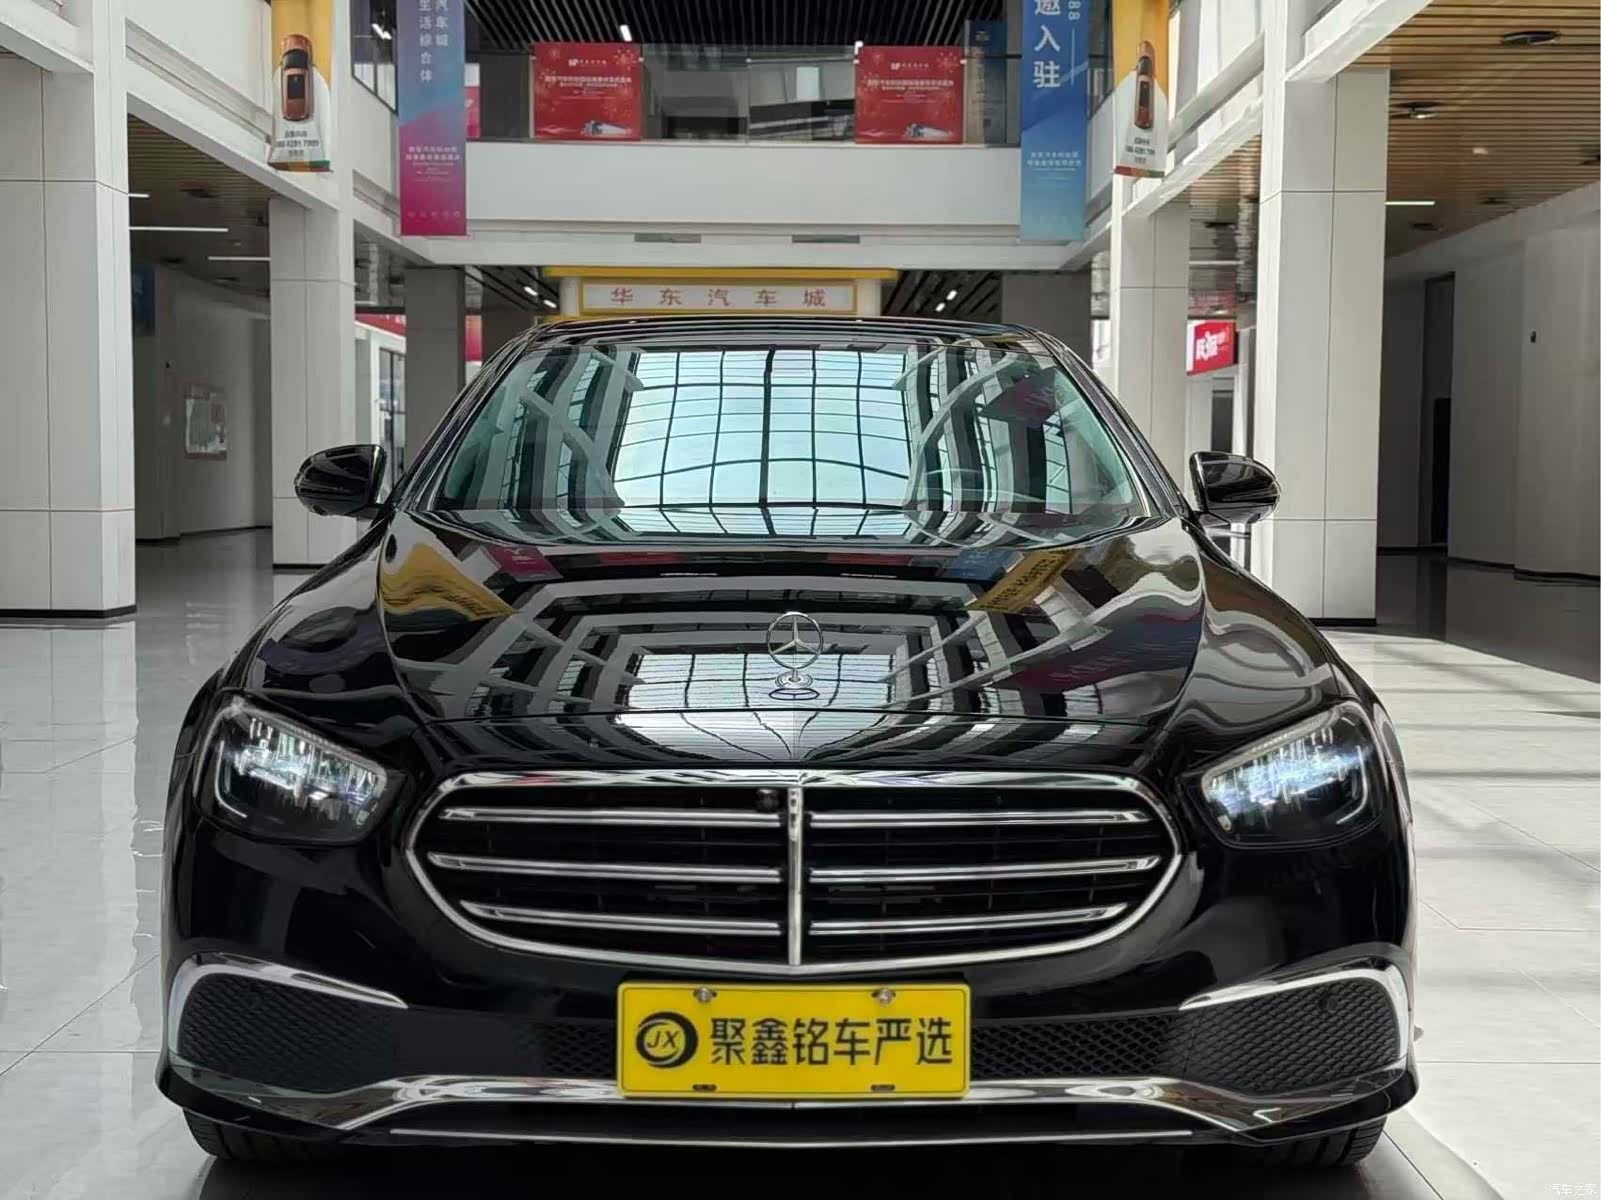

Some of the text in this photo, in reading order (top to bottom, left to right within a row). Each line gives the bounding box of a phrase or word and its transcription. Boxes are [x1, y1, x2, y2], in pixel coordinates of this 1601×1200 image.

[610, 287, 827, 308] 华东汽车城
[646, 1029, 682, 1051] JX
[710, 1016, 954, 1066] 聚鑫铭车严选
